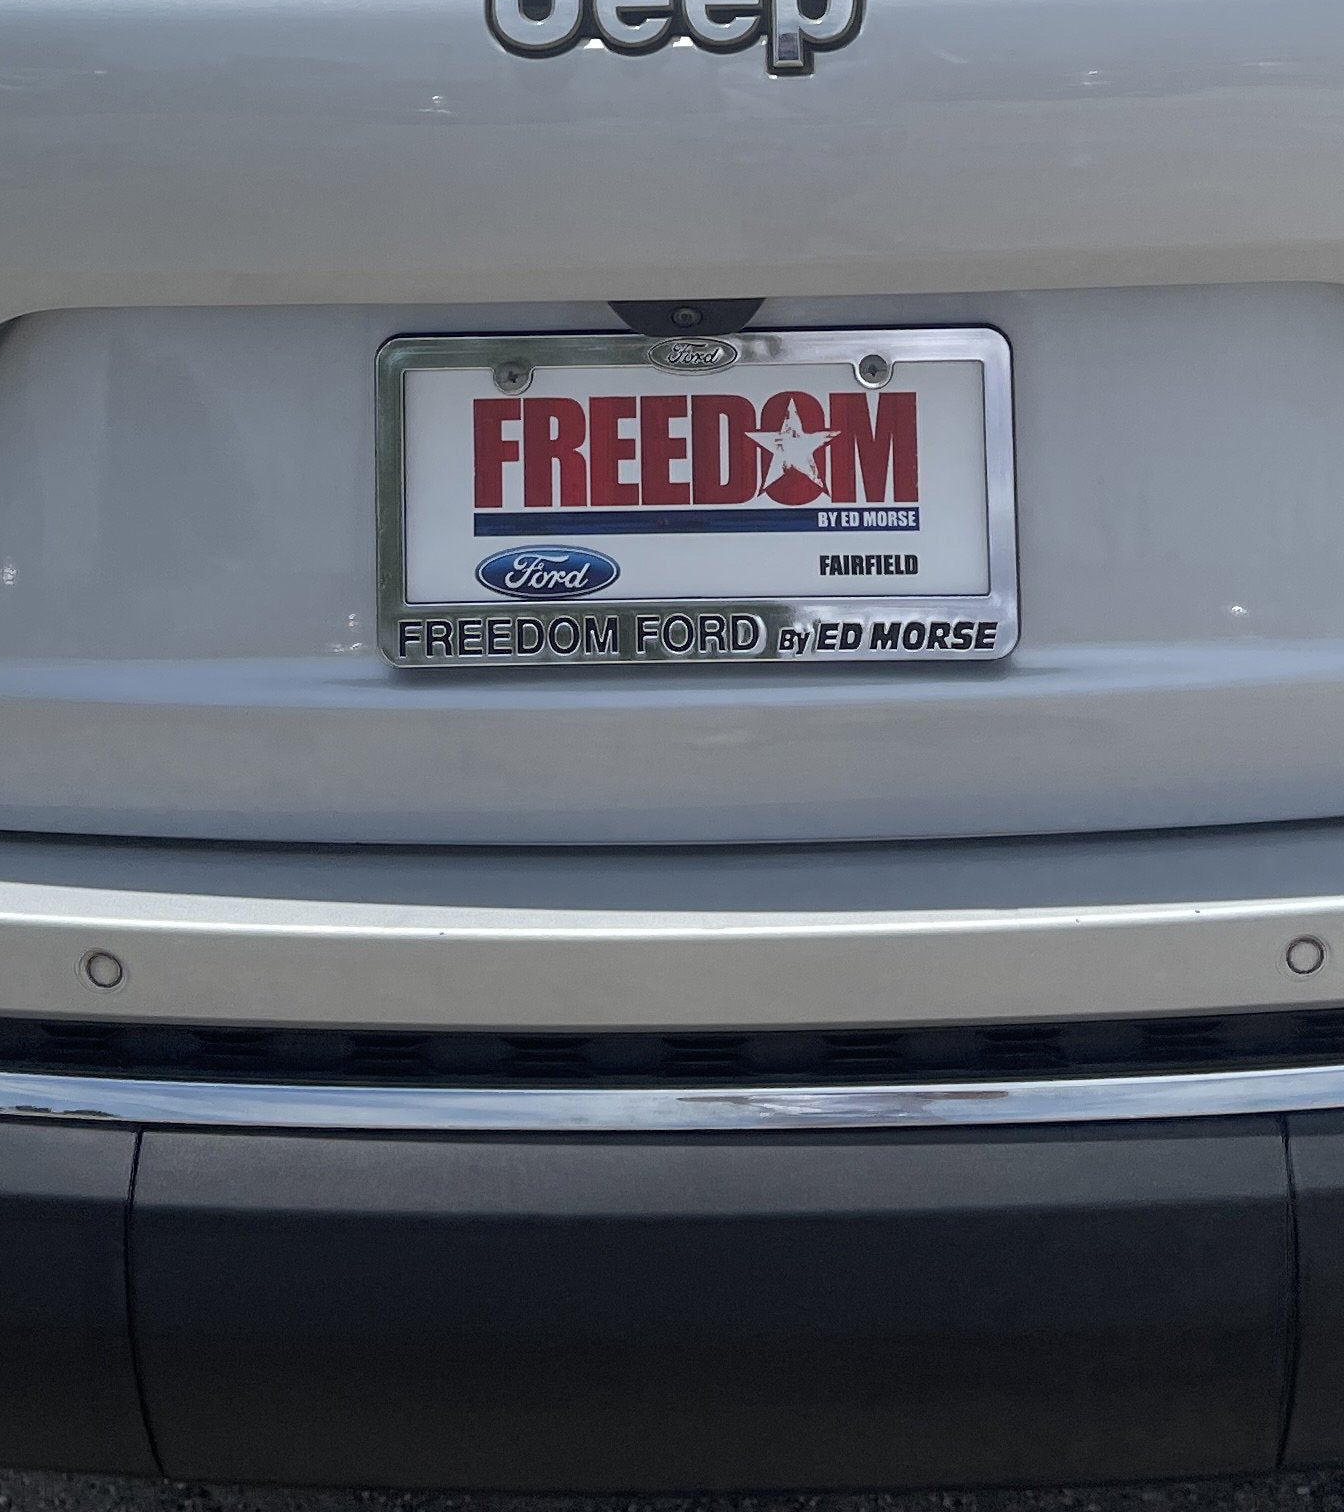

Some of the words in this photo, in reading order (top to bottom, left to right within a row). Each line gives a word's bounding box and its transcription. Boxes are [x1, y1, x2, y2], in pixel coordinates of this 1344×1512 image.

[667, 342, 725, 365] Ford
[473, 390, 919, 509] FREEDOM
[818, 511, 839, 528] BY
[841, 510, 860, 528] ED
[862, 509, 918, 528] MORSE
[503, 553, 592, 590] Ford
[819, 554, 919, 577] FAIRFIELD
[398, 615, 620, 658] FREEDOM
[635, 613, 762, 656] FORD
[778, 628, 812, 656] By
[815, 621, 863, 652] ED
[869, 620, 999, 652] MORSE
